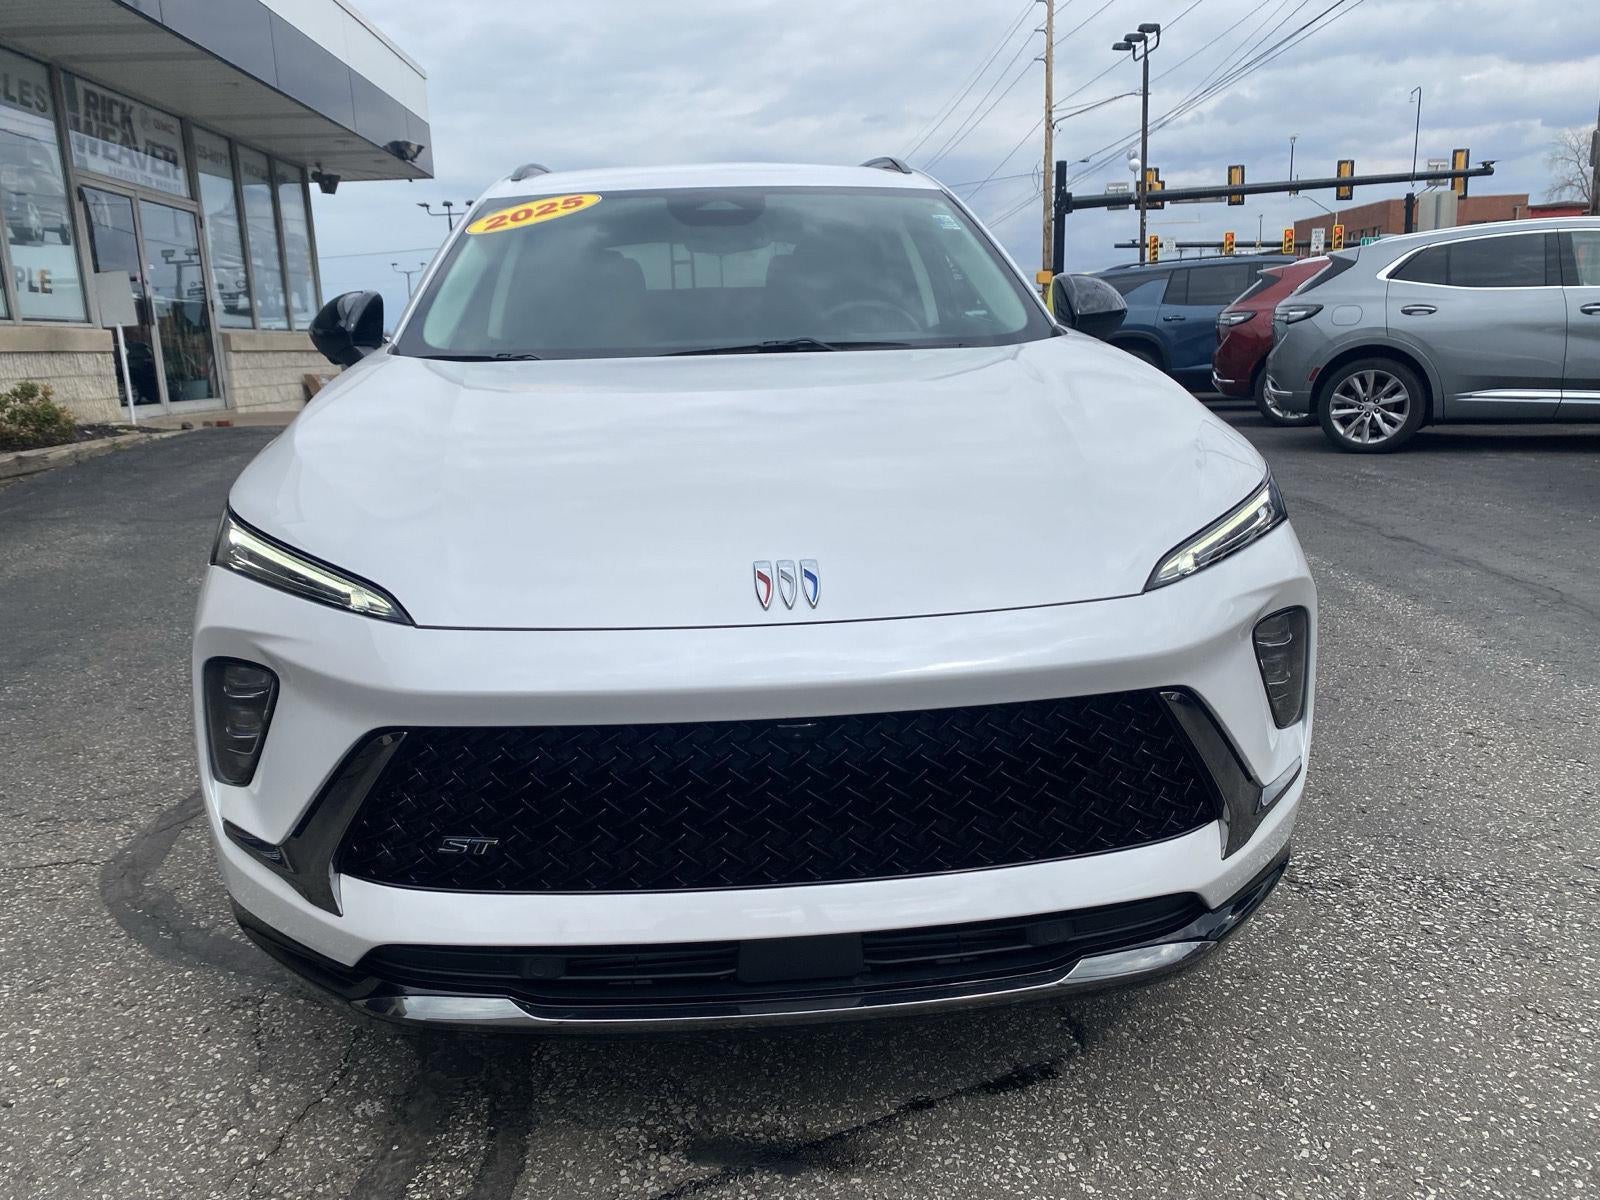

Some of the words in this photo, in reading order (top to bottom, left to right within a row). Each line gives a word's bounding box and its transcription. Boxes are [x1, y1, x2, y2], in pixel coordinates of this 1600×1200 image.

[0, 72, 48, 113] LES
[82, 87, 136, 133] RICK
[68, 112, 180, 181] WEAVER
[484, 195, 585, 232] 2025
[437, 836, 500, 856] ST
